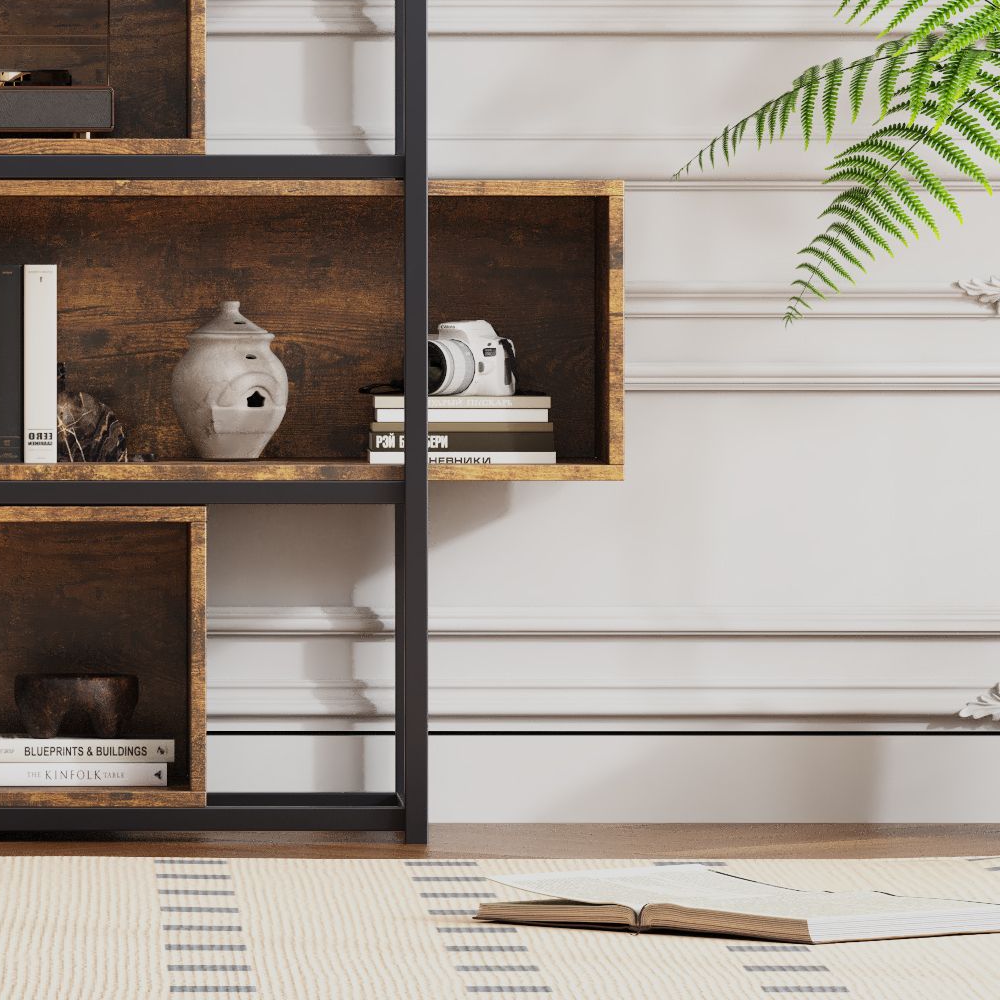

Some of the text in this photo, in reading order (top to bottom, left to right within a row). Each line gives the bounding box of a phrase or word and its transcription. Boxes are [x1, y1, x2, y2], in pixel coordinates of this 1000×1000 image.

[376, 433, 395, 449] РЭЙ
[24, 746, 148, 757] BLUEPRINTS & BUILDINGS
[45, 769, 102, 781] KINFOLK
